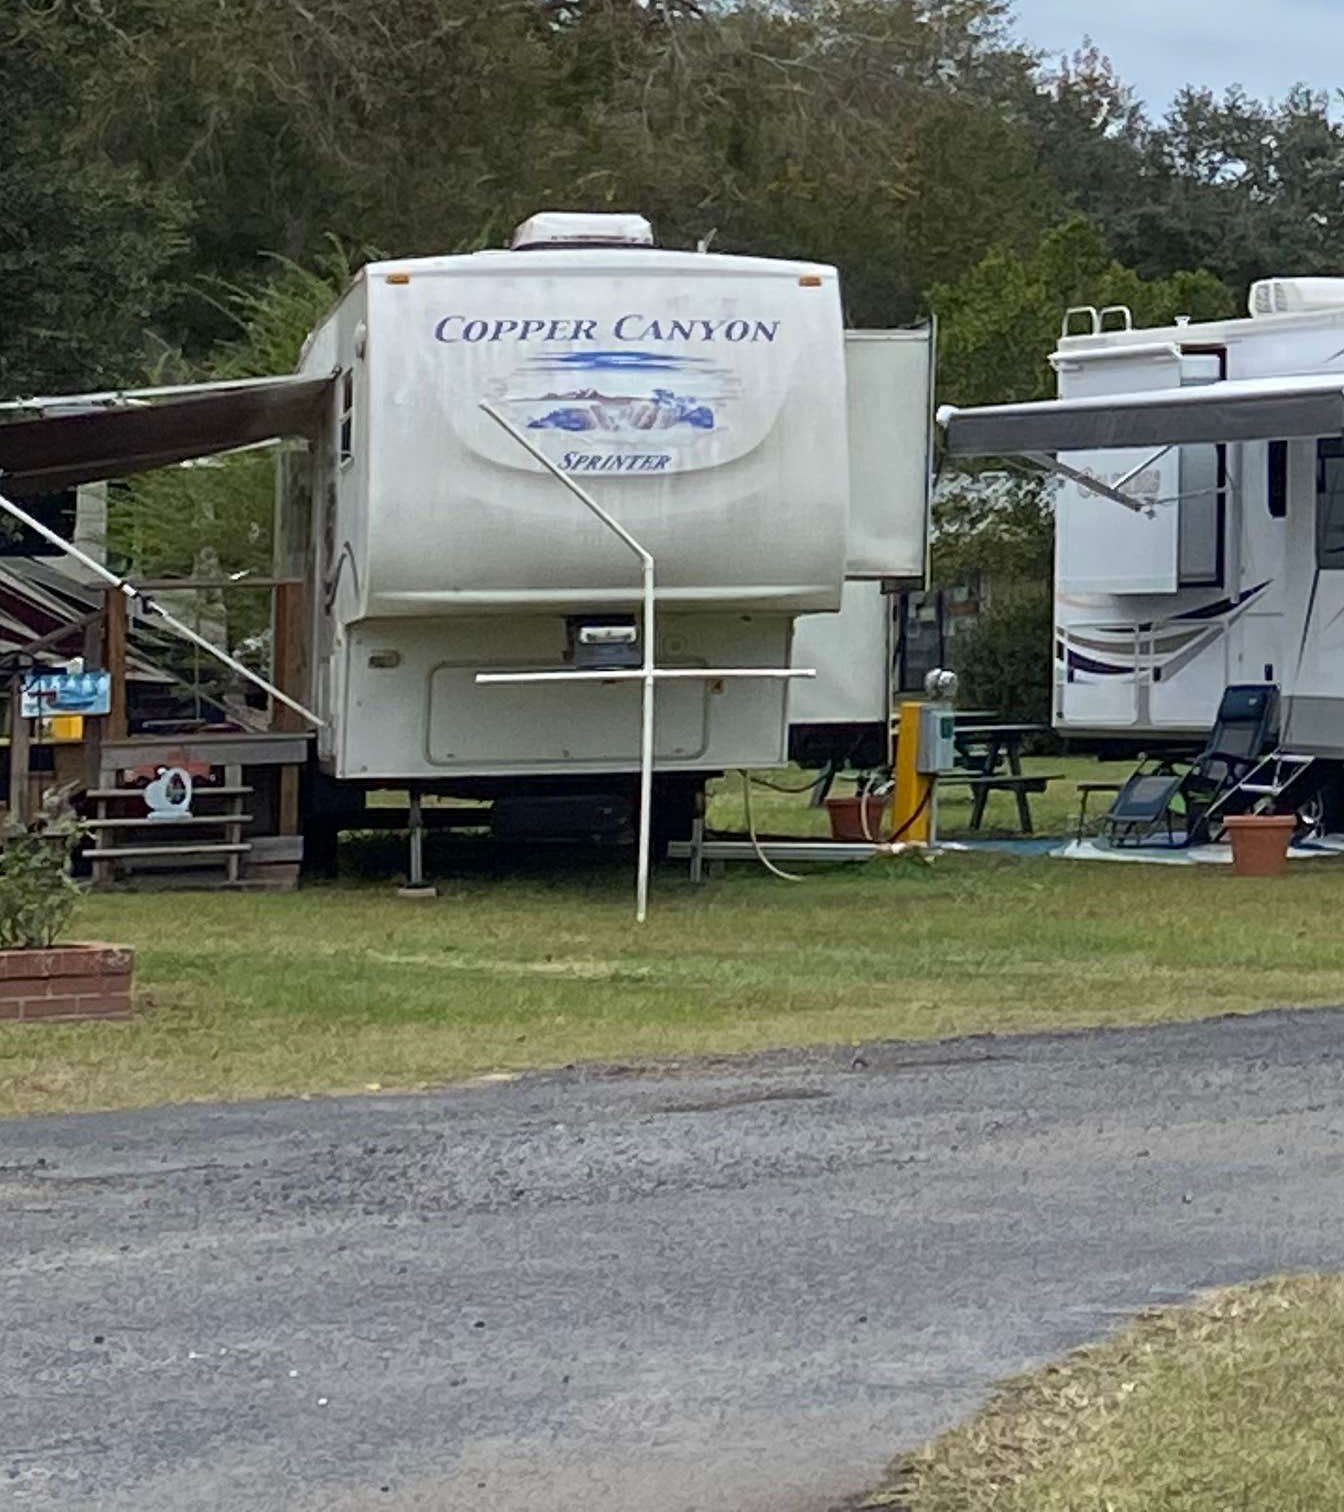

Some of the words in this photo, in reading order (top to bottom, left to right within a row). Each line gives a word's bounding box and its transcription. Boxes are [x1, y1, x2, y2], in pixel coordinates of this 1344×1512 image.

[434, 315, 599, 344] COPPER
[614, 314, 782, 343] CANYON
[557, 451, 673, 472] SPRINTER
